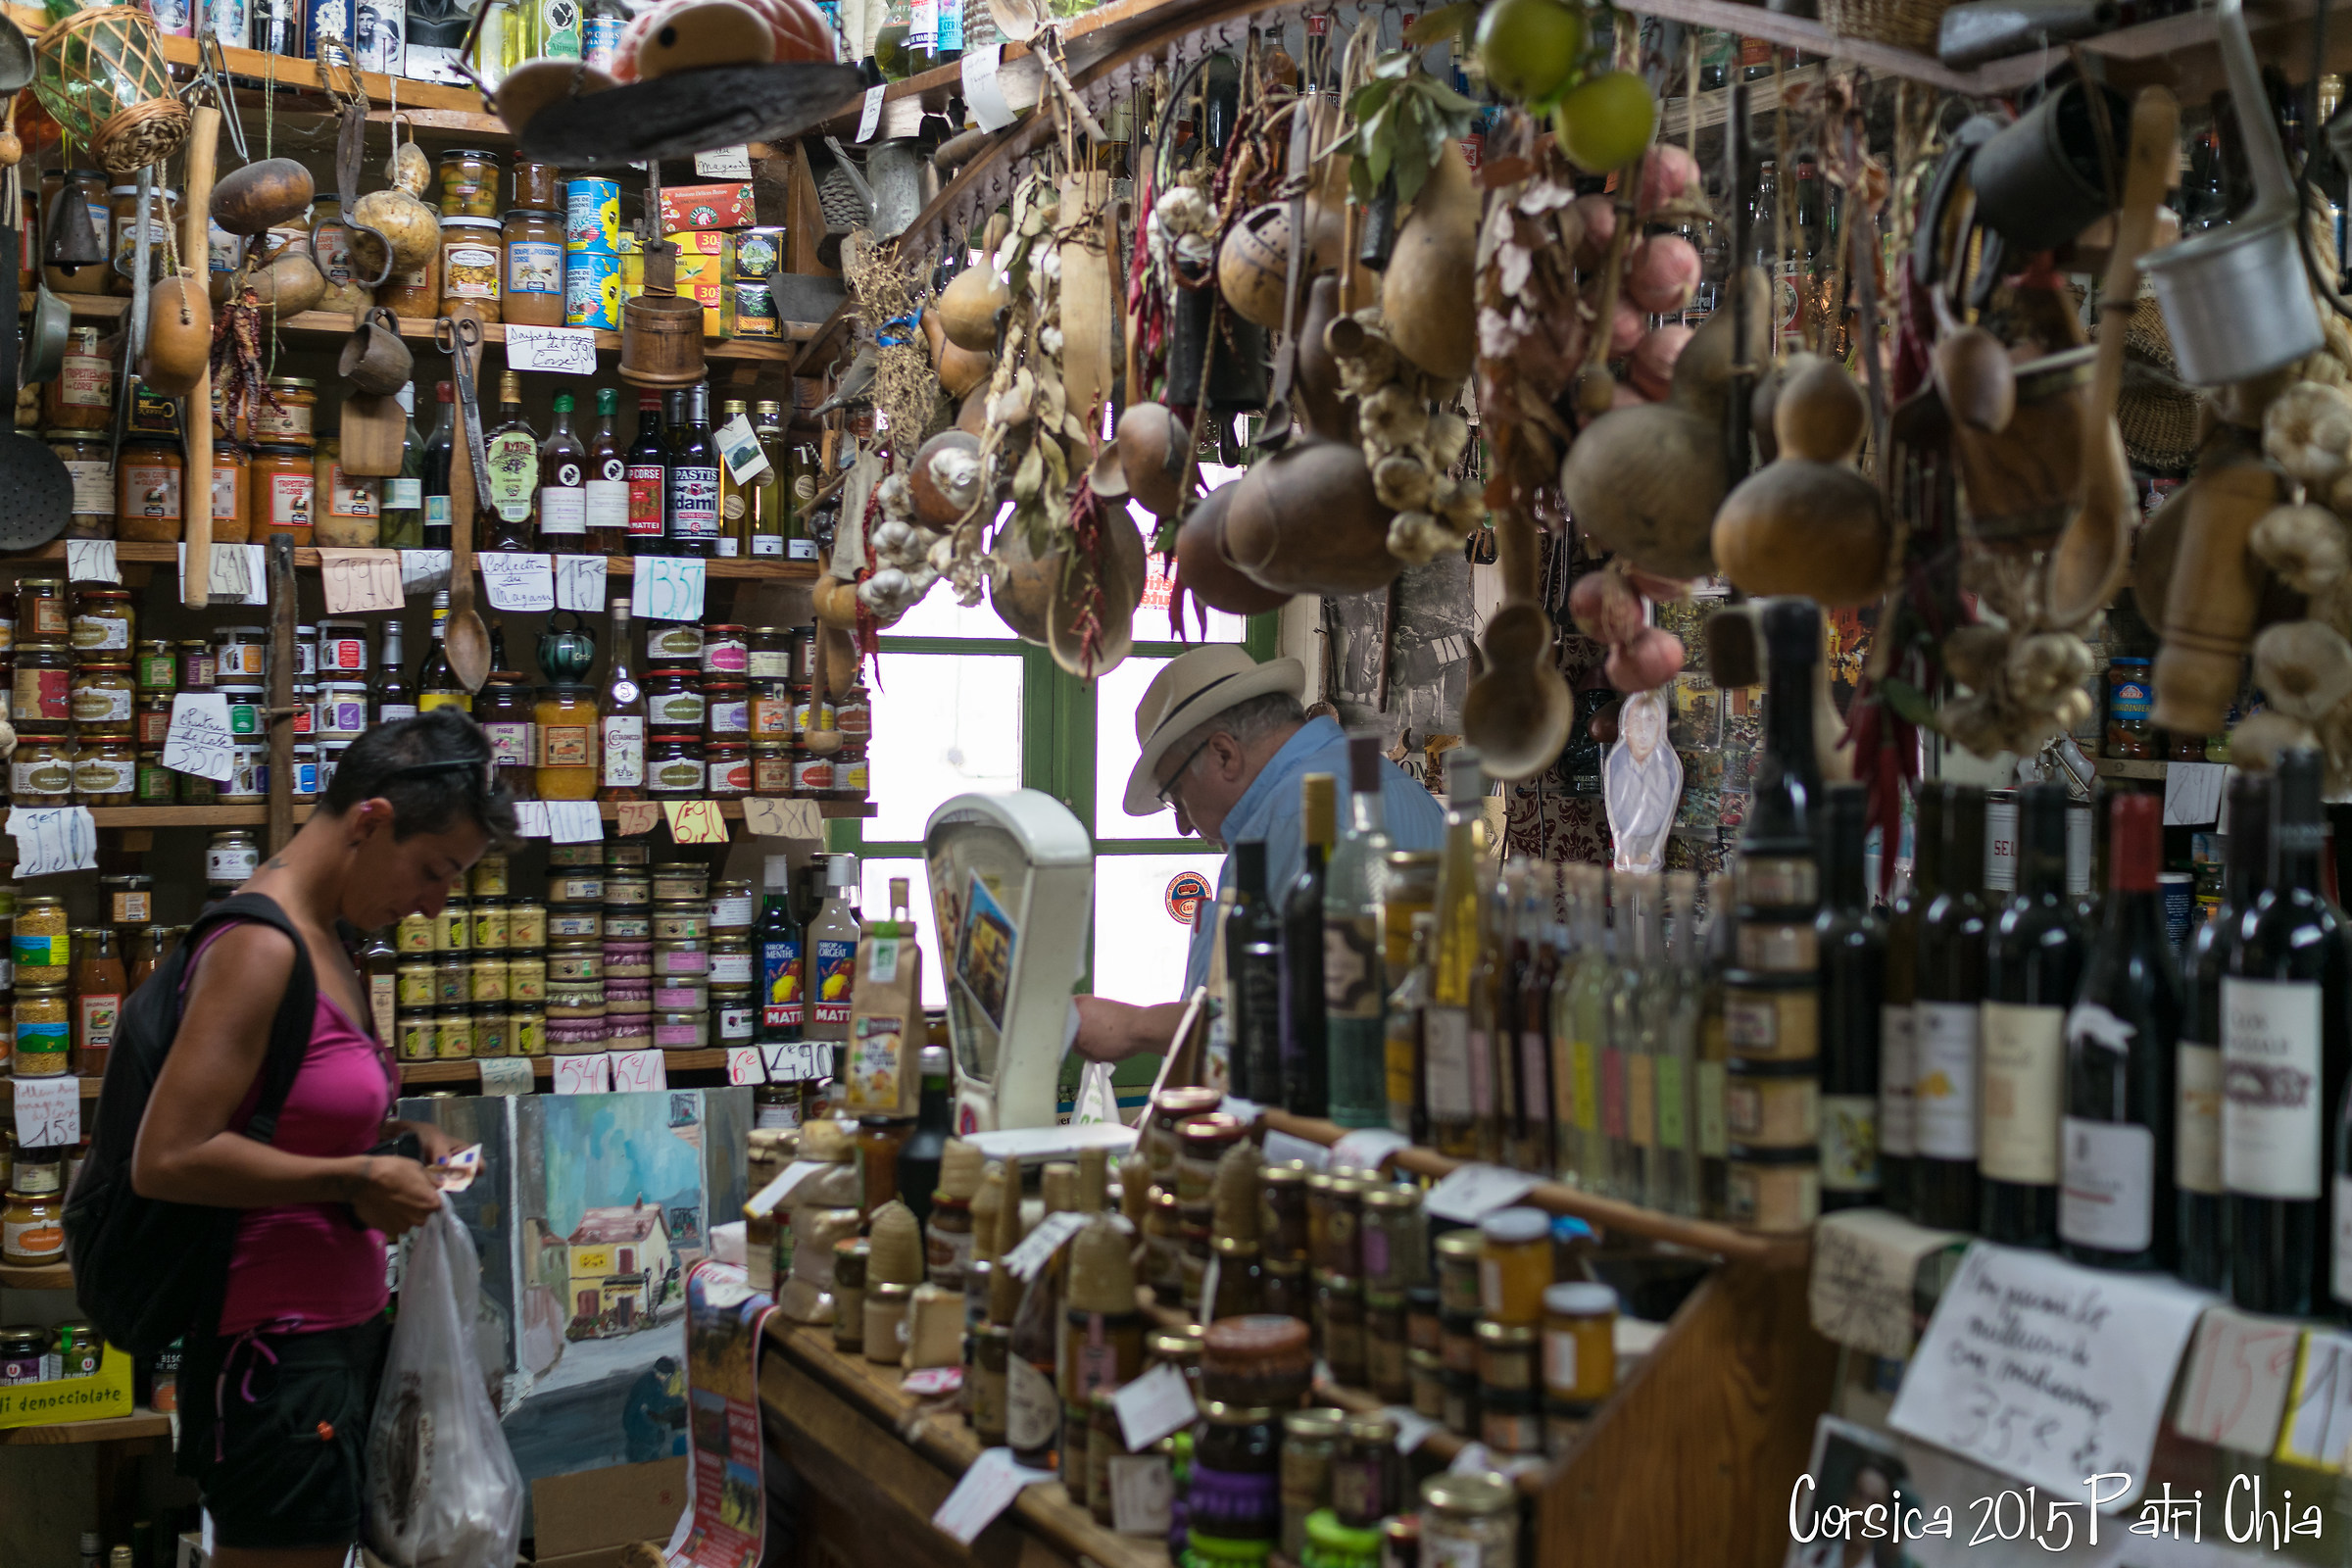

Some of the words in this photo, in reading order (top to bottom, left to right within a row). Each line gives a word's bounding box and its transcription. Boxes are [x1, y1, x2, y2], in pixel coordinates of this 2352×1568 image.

[701, 235, 717, 245] 30
[700, 287, 716, 297] 30
[73, 382, 94, 391] CORSE
[633, 468, 661, 479] CORSE
[675, 469, 718, 481] PASTIS
[764, 949, 794, 958] MENTHE
[817, 948, 847, 957] ORGEAT
[19, 1388, 122, 1412] denocciolate
